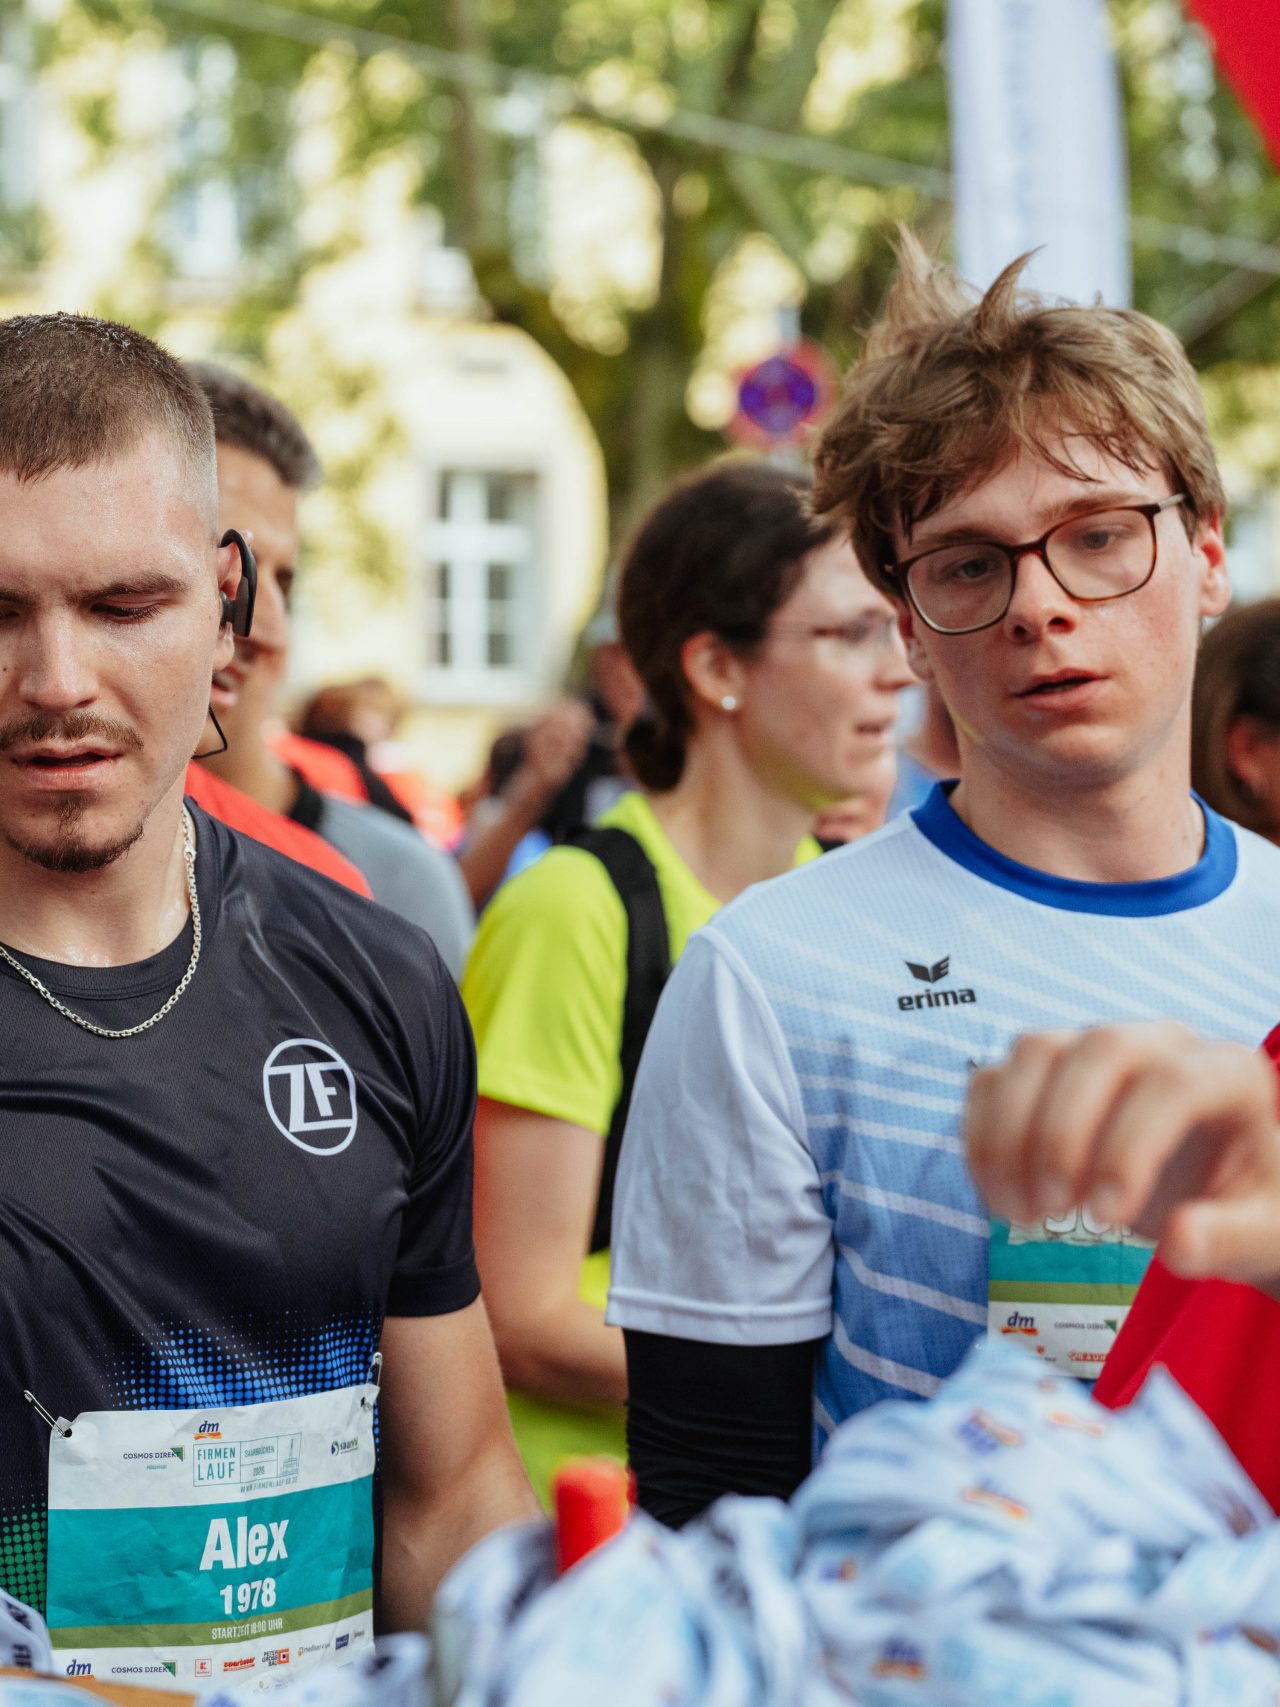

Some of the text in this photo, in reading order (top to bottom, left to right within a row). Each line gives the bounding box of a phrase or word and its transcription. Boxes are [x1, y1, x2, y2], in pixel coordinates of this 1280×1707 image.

[897, 988, 976, 1012] erima
[263, 1061, 356, 1133] ZF
[1007, 1311, 1035, 1328] dm
[199, 1420, 220, 1434] dm
[123, 1452, 154, 1460] COSMOS
[197, 1447, 236, 1461] FIRMEN
[197, 1462, 236, 1481] LAUF
[198, 1515, 289, 1571] Alex
[219, 1577, 277, 1615] 1978
[211, 1622, 250, 1640] STARTZEIT
[268, 1617, 283, 1632] UHR
[66, 1659, 92, 1677] dm
[111, 1666, 143, 1674] COSMOS
